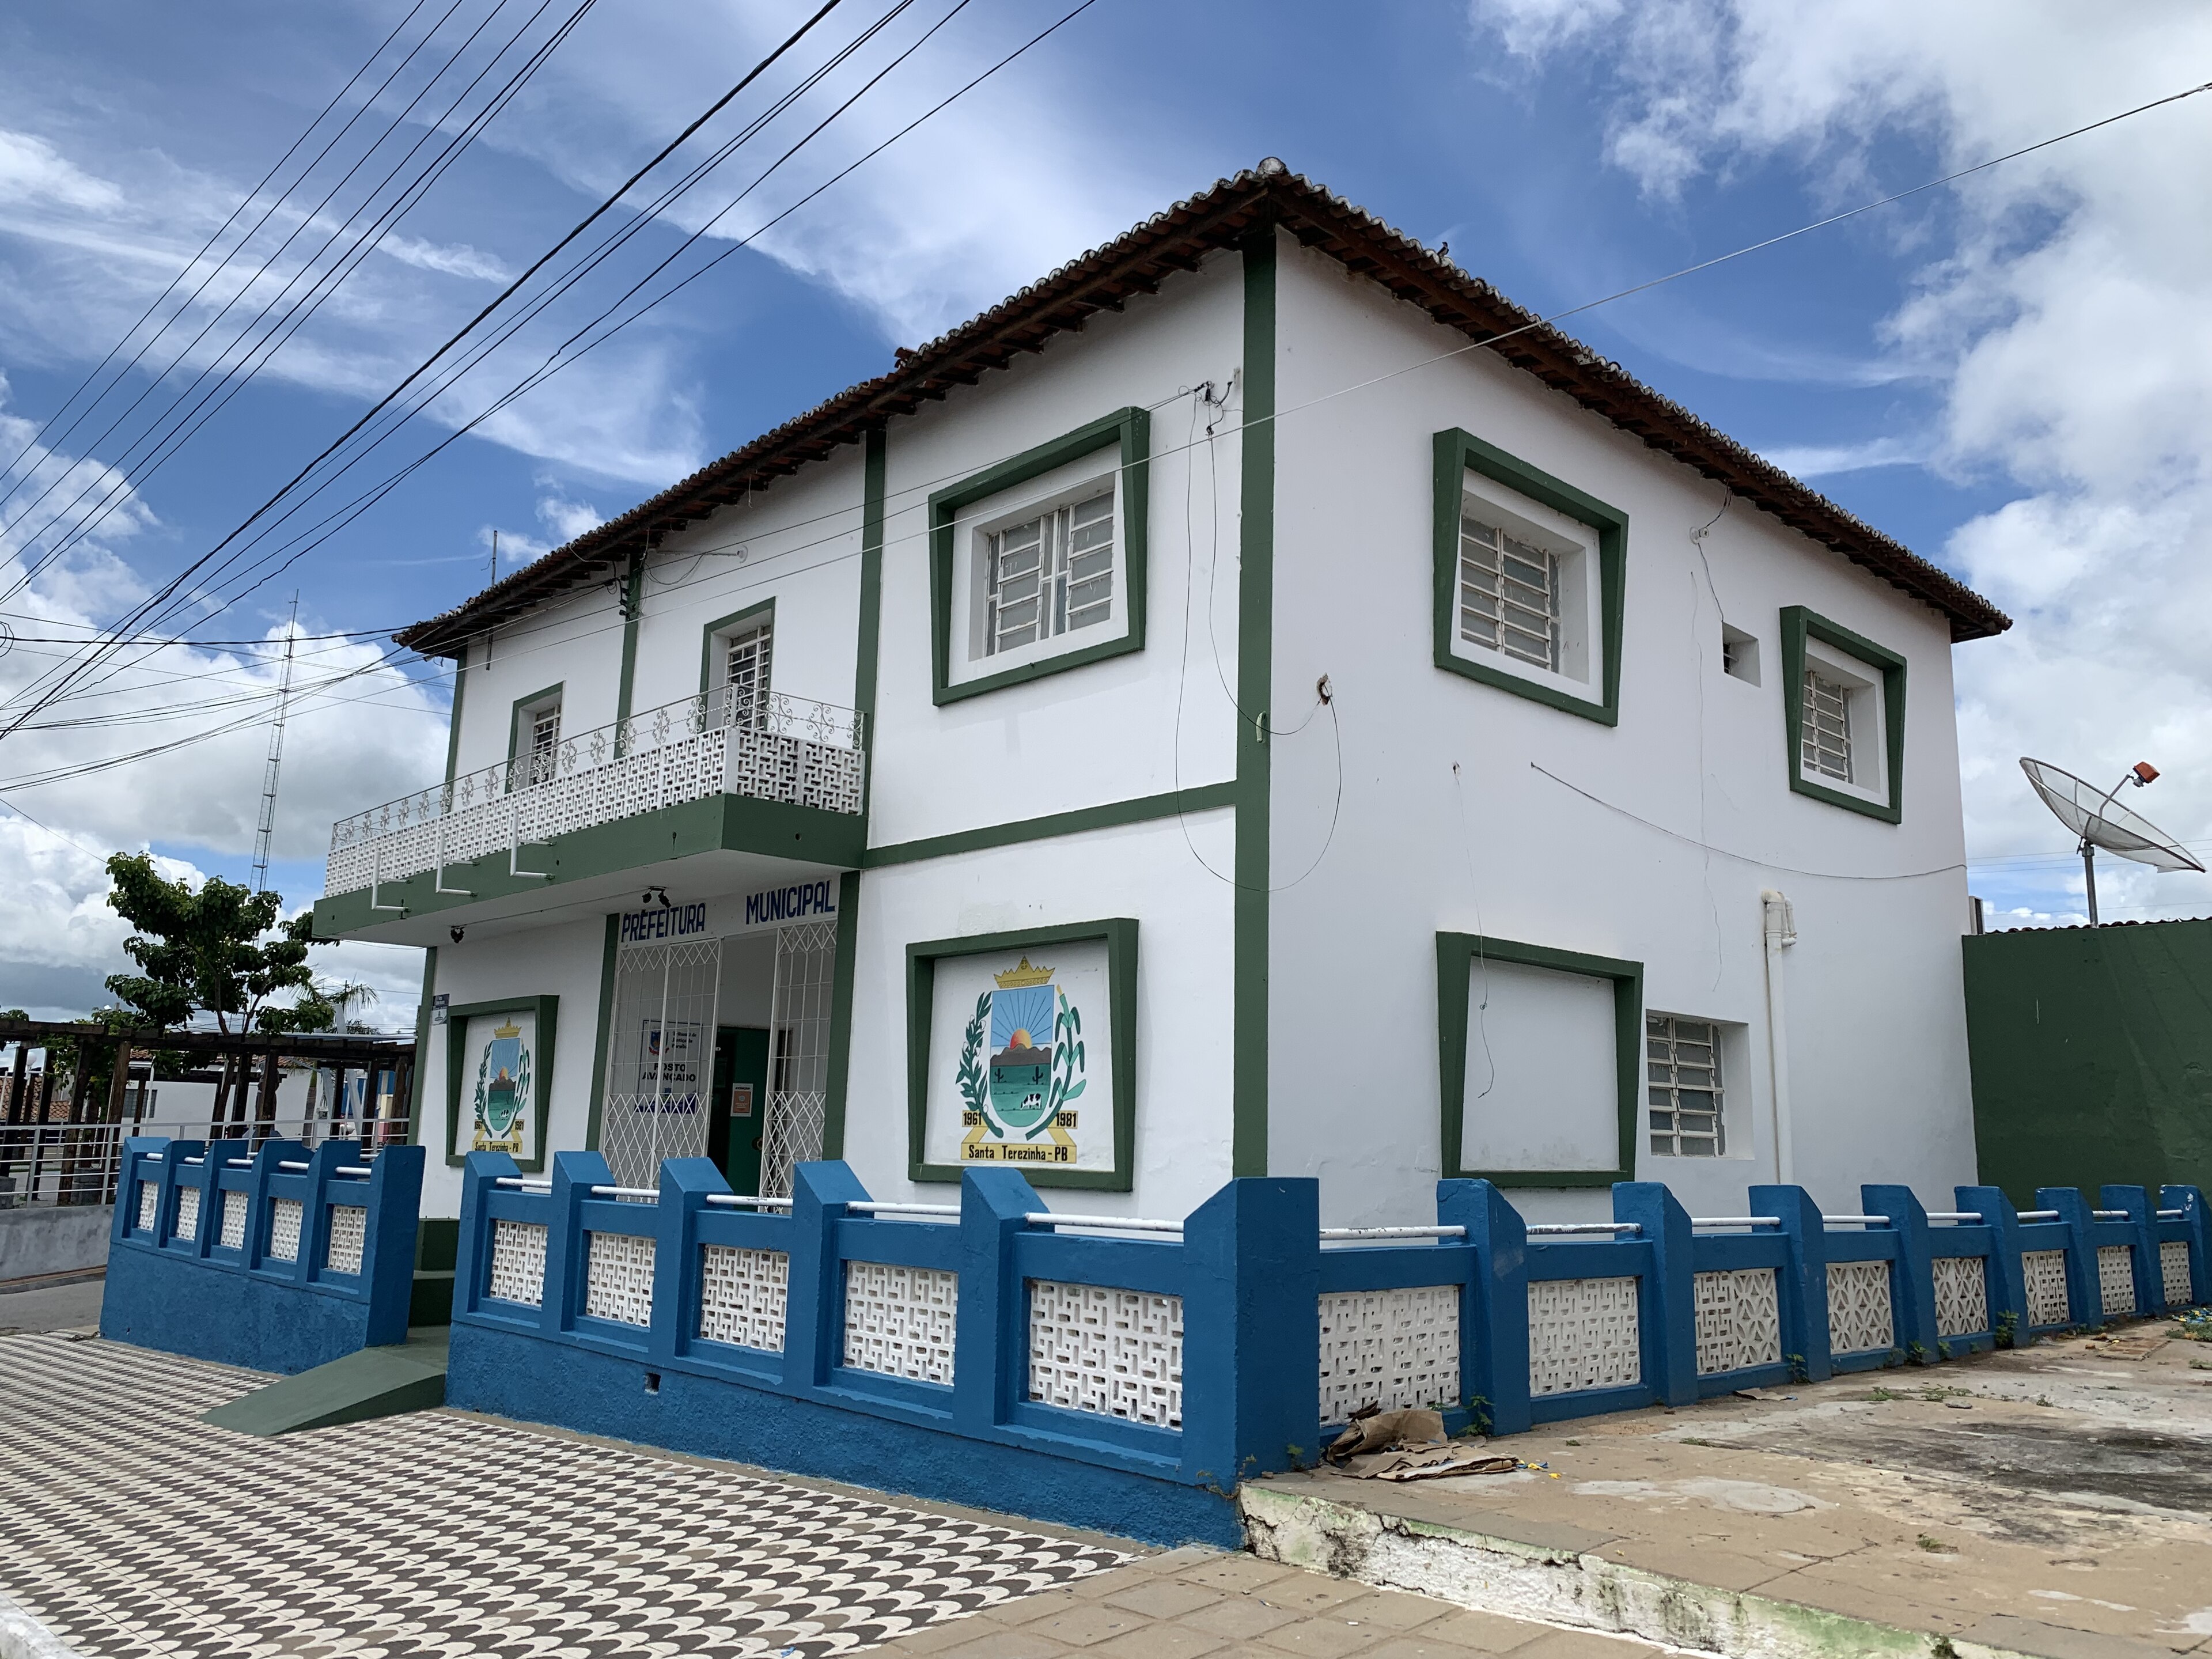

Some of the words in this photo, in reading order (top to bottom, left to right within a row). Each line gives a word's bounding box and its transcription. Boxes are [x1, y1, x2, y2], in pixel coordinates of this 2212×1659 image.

[622, 903, 706, 942] PREFEITURA
[746, 880, 835, 925] MUNICIPAL
[963, 1112, 982, 1125] 1961
[1056, 1113, 1077, 1127] 1981
[475, 1142, 486, 1151] Santa
[489, 1142, 508, 1152] Terezinha
[513, 1143, 519, 1152] PB
[969, 1145, 994, 1158] Santa
[1002, 1145, 1046, 1160] Terezinha
[1055, 1147, 1067, 1161] PB
